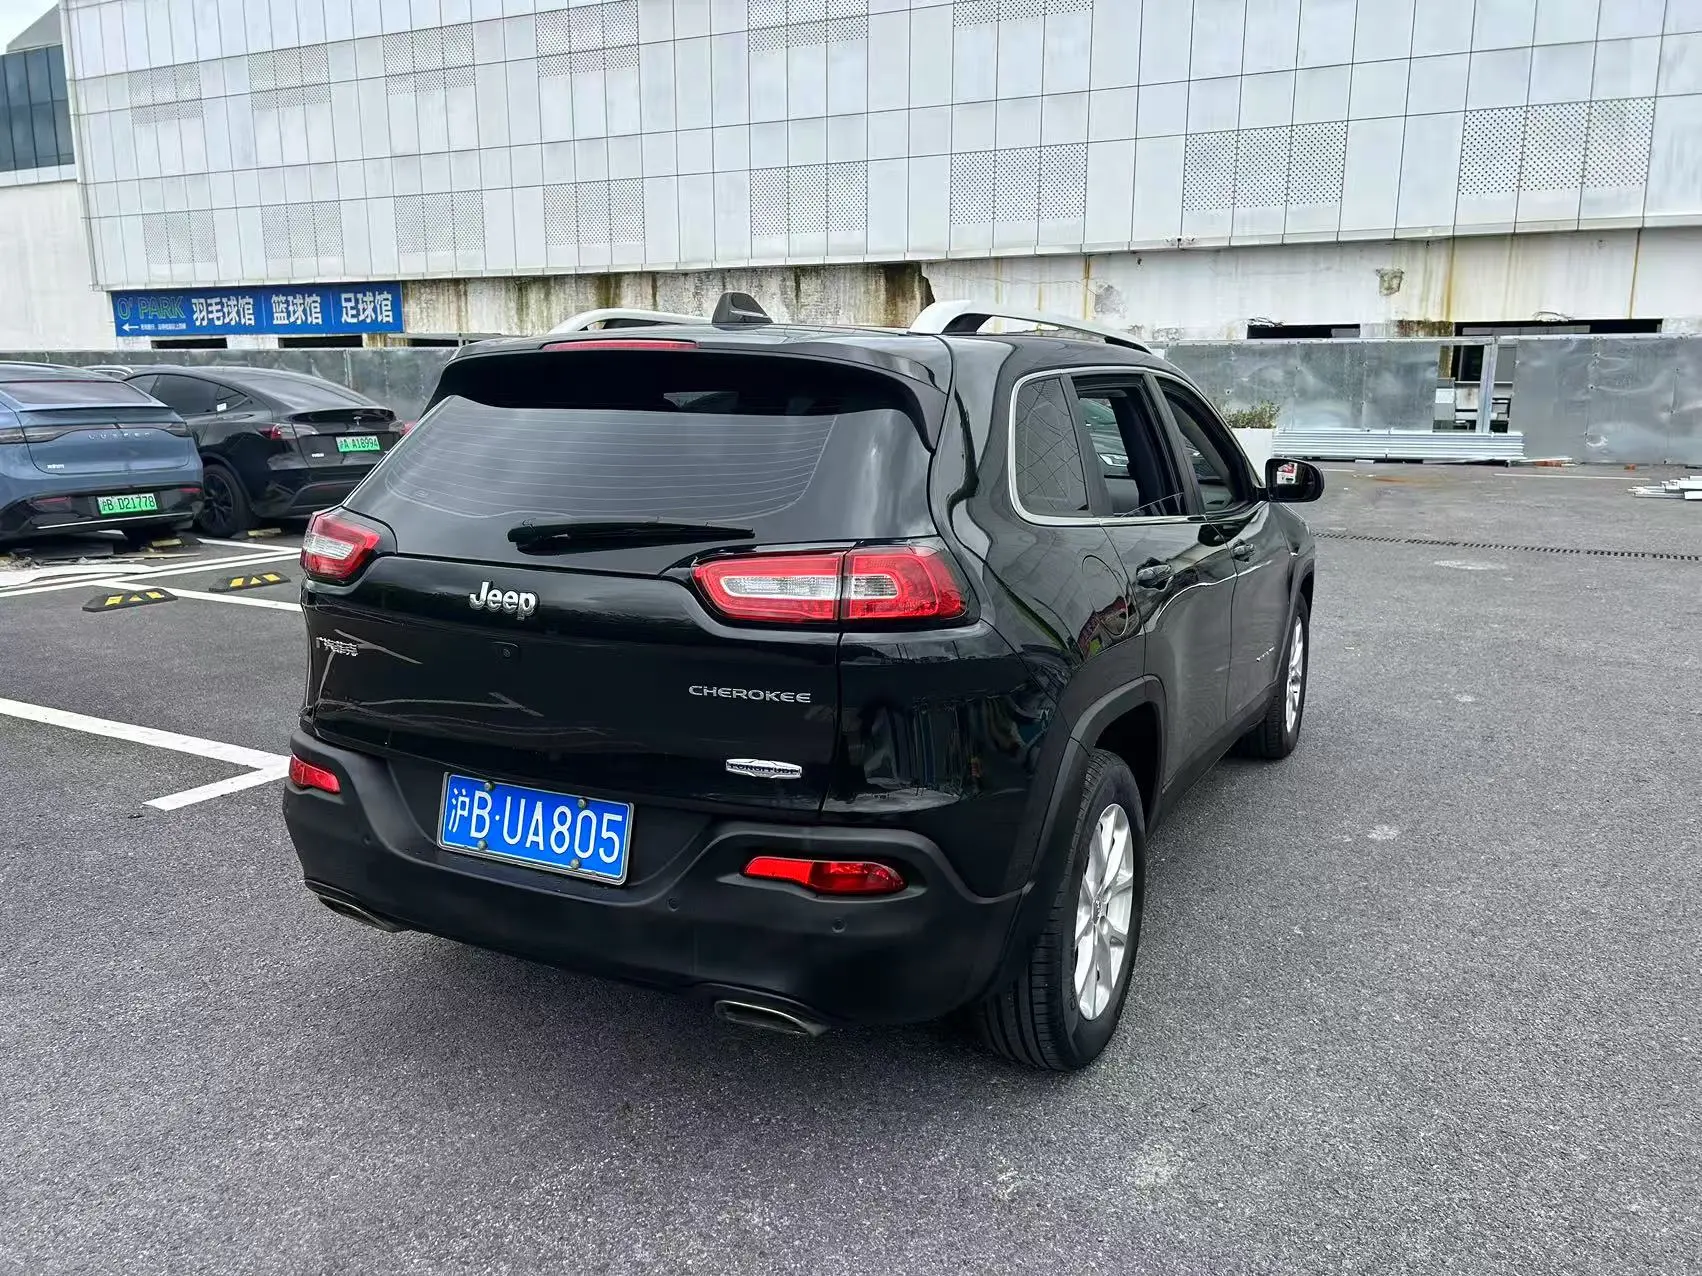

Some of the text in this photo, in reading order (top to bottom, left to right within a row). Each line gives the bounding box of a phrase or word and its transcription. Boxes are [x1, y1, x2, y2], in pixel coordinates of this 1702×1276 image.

[138, 296, 186, 320] PARK
[192, 291, 394, 327] 羽毛球馆 篮球馆 足球馆
[469, 580, 538, 620] Jeep
[688, 685, 812, 703] CHEROKEE
